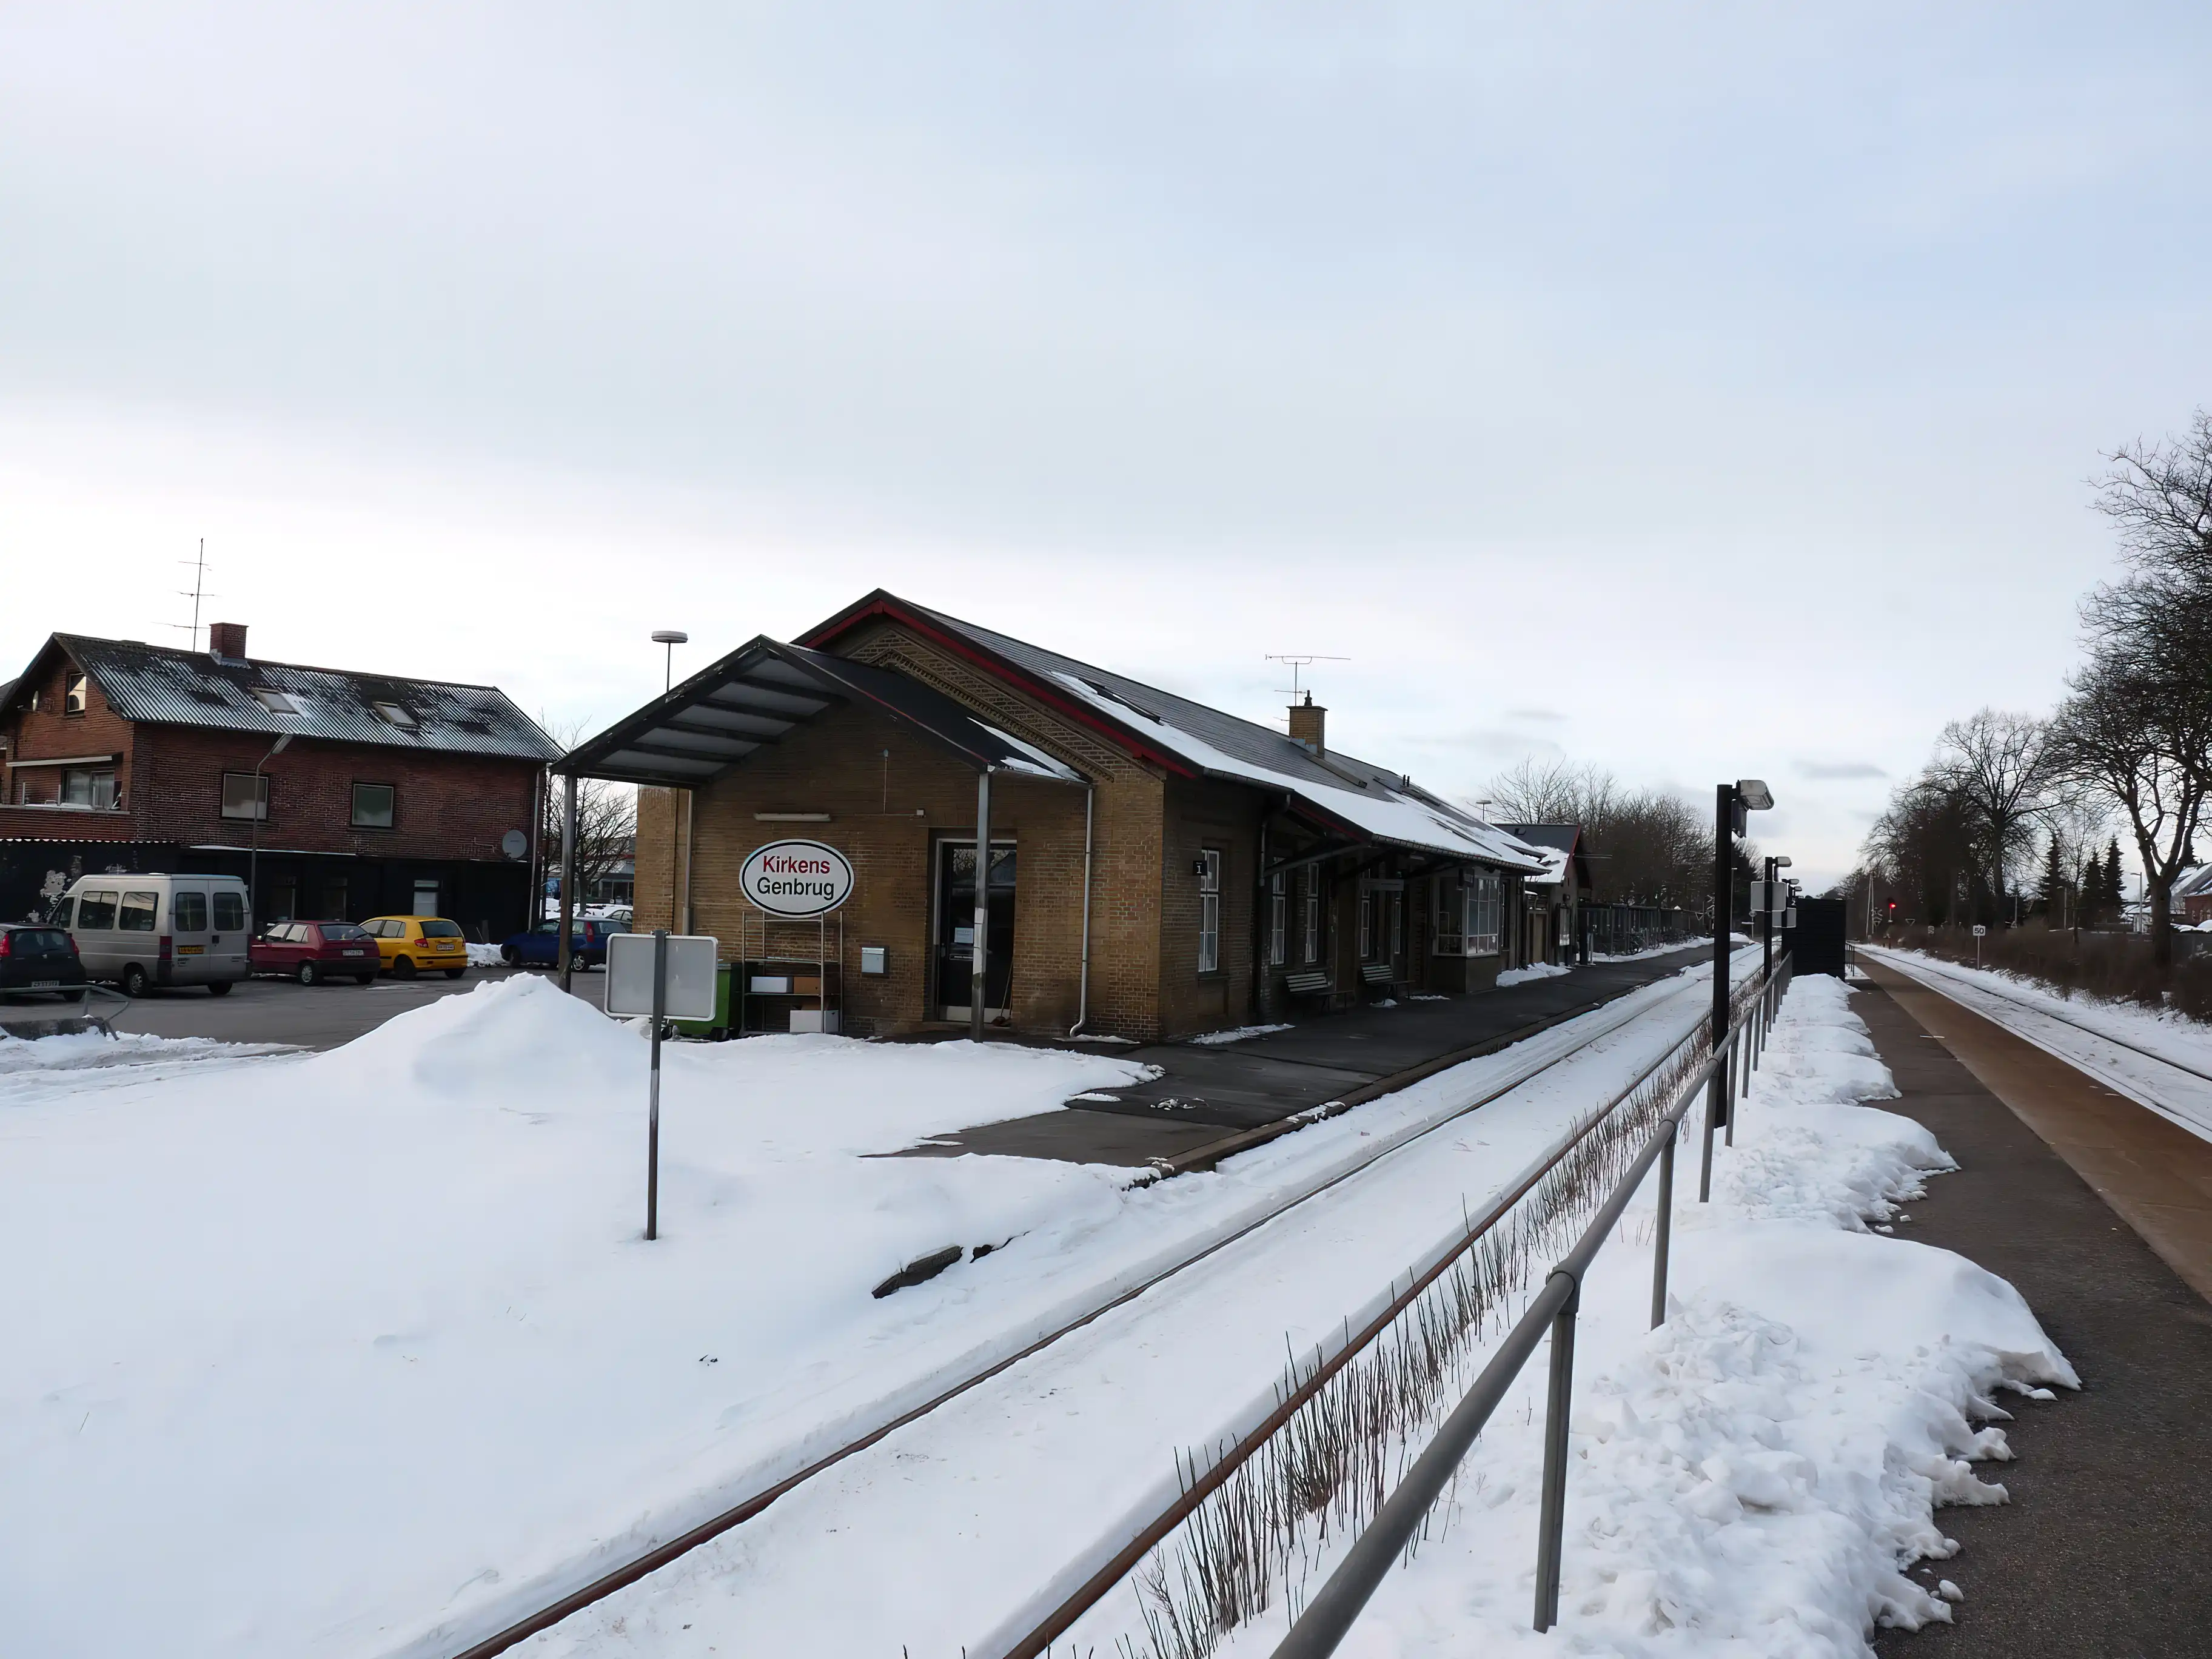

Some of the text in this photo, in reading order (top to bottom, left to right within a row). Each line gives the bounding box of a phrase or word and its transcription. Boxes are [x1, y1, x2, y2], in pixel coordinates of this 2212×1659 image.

[763, 855, 831, 874] Kirkens
[1196, 865, 1202, 874] 1
[757, 876, 834, 901] Genbrug
